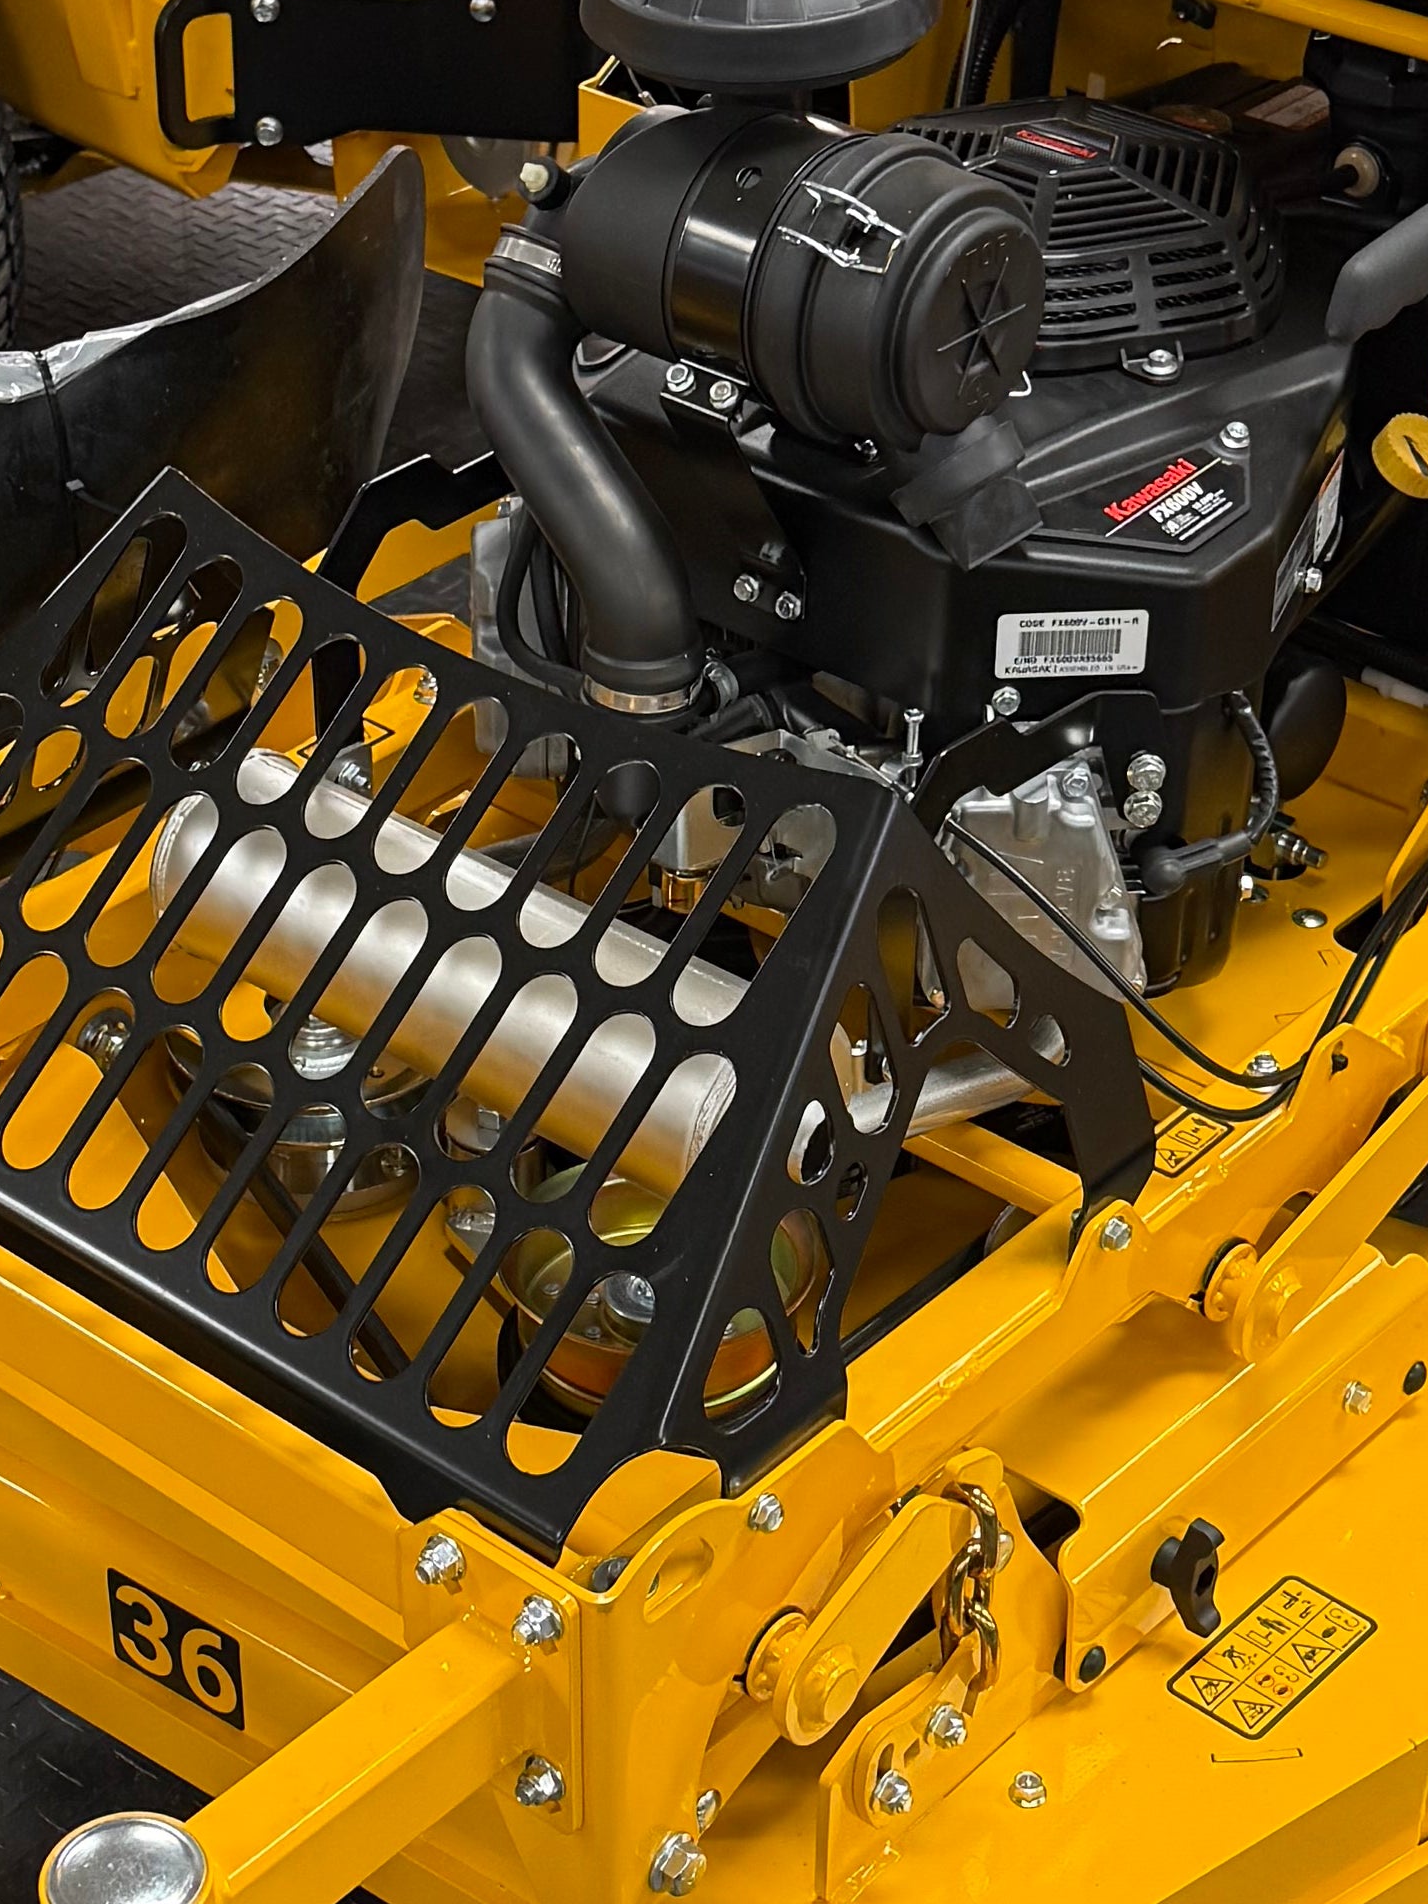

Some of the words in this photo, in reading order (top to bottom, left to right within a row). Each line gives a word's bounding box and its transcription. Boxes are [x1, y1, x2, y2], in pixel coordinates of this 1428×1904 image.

[1103, 457, 1199, 522] Kawasaki
[1148, 480, 1204, 523] FX600V
[115, 1585, 238, 1713] 36
